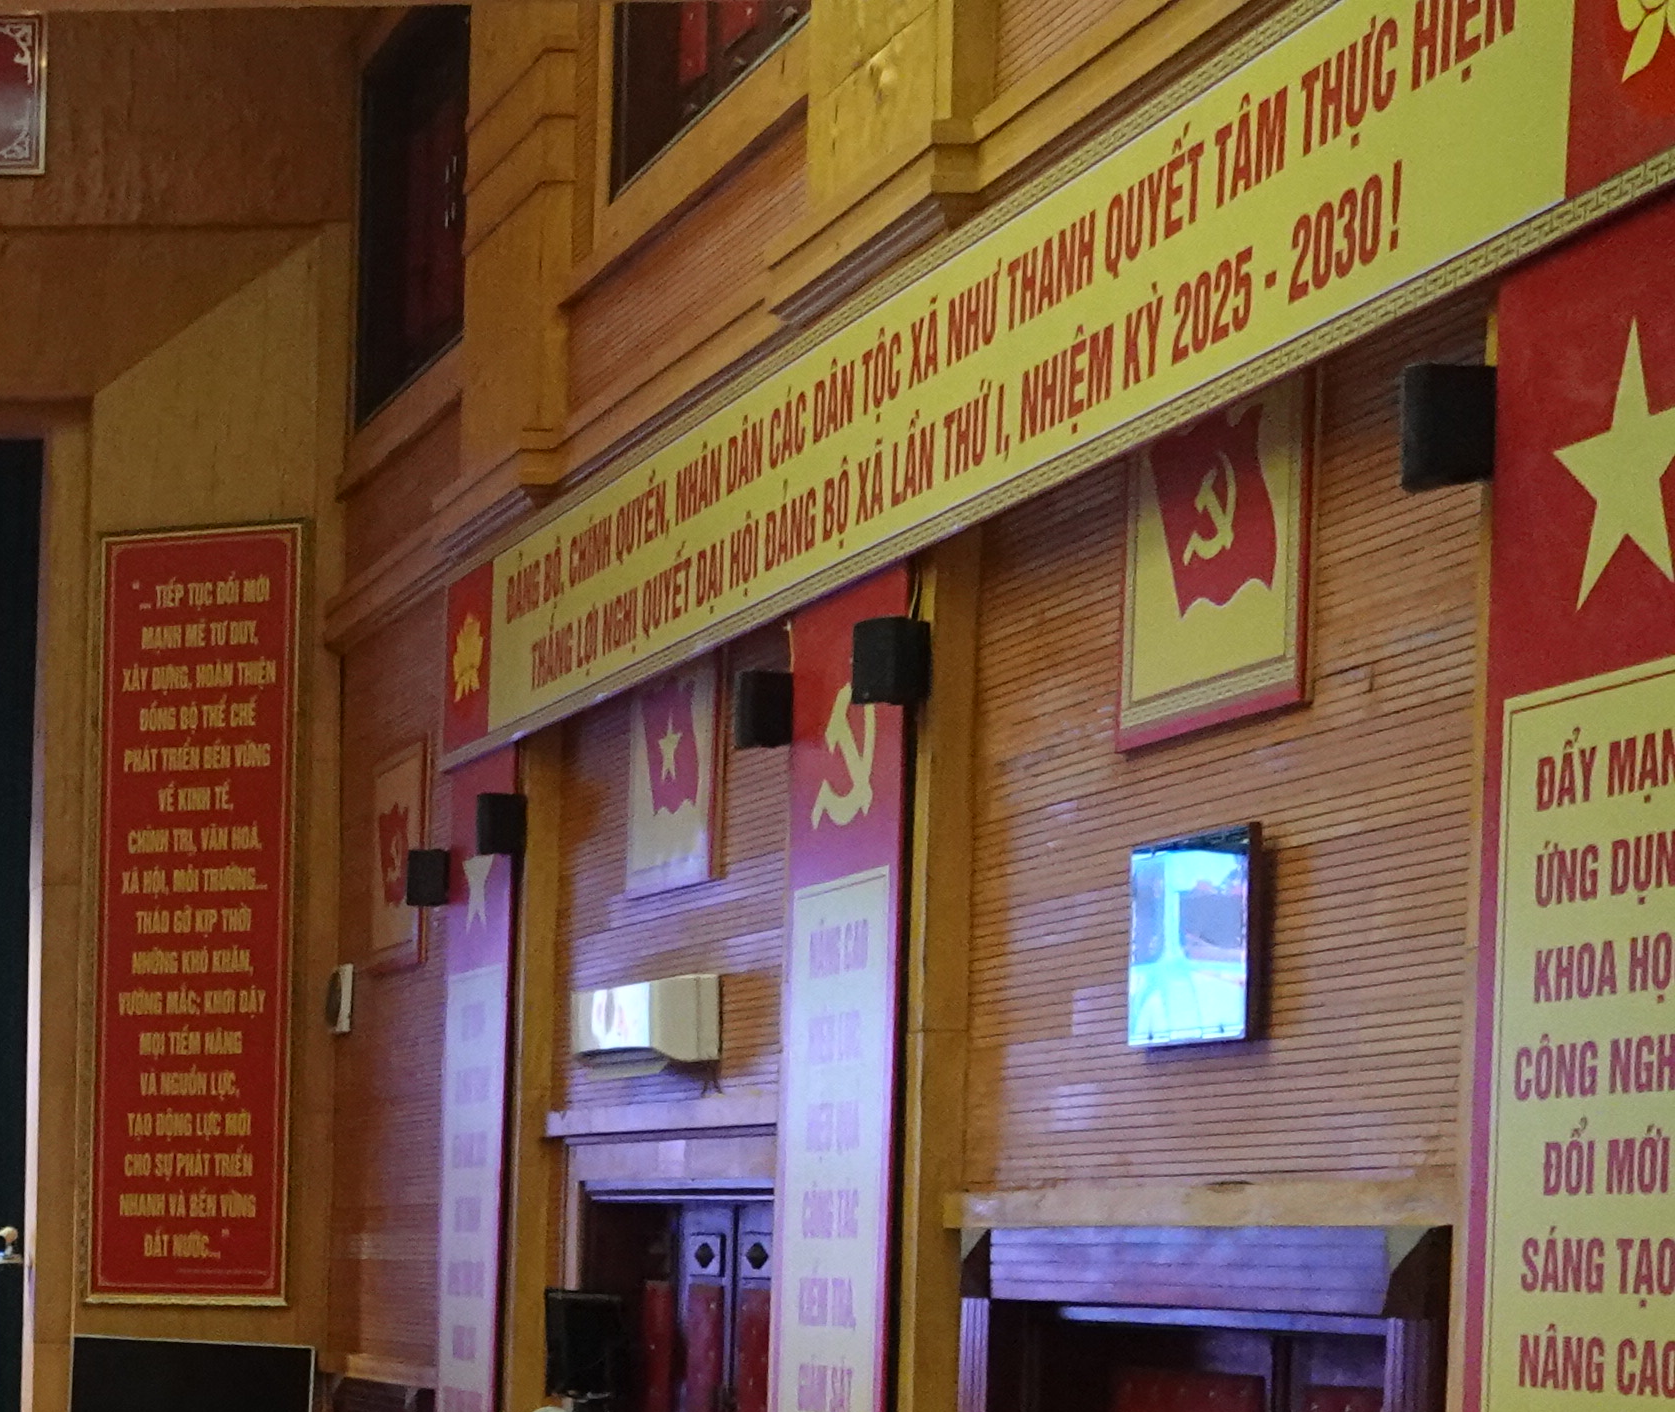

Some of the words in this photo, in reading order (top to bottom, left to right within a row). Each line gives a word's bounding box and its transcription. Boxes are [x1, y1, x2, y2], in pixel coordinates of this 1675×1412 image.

[505, 549, 541, 624] ĐẢNG
[568, 510, 612, 588] CHÍNH
[614, 468, 670, 564] QUYỀN,
[674, 440, 722, 528] NHÂN
[726, 414, 763, 498] DÂN
[767, 385, 808, 467] CÁC
[812, 357, 856, 446] DÂN
[859, 326, 902, 422] TỘC
[907, 297, 939, 391] XÃ
[945, 257, 1001, 368] NHƯ
[1006, 209, 1097, 331] THANH
[1103, 121, 1205, 280] QUYẾT
[1213, 85, 1290, 210] TÂM
[1300, 14, 1398, 157] THỰC
[529, 612, 573, 689] THẮNG
[575, 607, 600, 676] LỢI
[600, 584, 639, 657] NGHỊ
[641, 537, 693, 637] QUYẾT
[695, 542, 725, 612] ĐẠI
[727, 510, 761, 597] HỘI
[763, 479, 818, 572] ĐẢNG
[820, 454, 850, 550] BỘ
[853, 437, 886, 527] XÃ
[888, 410, 935, 506] LẦN
[943, 377, 989, 482] THỨ
[994, 383, 1010, 462] I,
[1019, 323, 1113, 444] NHIỆM
[1122, 281, 1164, 391] KỲ
[1170, 244, 1253, 366] 2025
[1263, 269, 1278, 290] -
[1536, 726, 1597, 812] ĐẨY
[1607, 728, 1675, 803] MẠN
[1535, 840, 1600, 908] ỨNG
[1610, 829, 1675, 905] DỤN
[1533, 940, 1618, 1004] KHOA
[1628, 931, 1675, 1003] HỌ
[1514, 1033, 1598, 1101] CÔNG
[1609, 1034, 1675, 1095] NGH
[1543, 1116, 1595, 1196] ĐỔI
[1605, 1123, 1670, 1195] MỚI
[1520, 1224, 1605, 1295] SÁNG
[1616, 1237, 1675, 1308] TẠO
[1518, 1323, 1605, 1394] NÂNG
[1616, 1337, 1675, 1400] CAO
